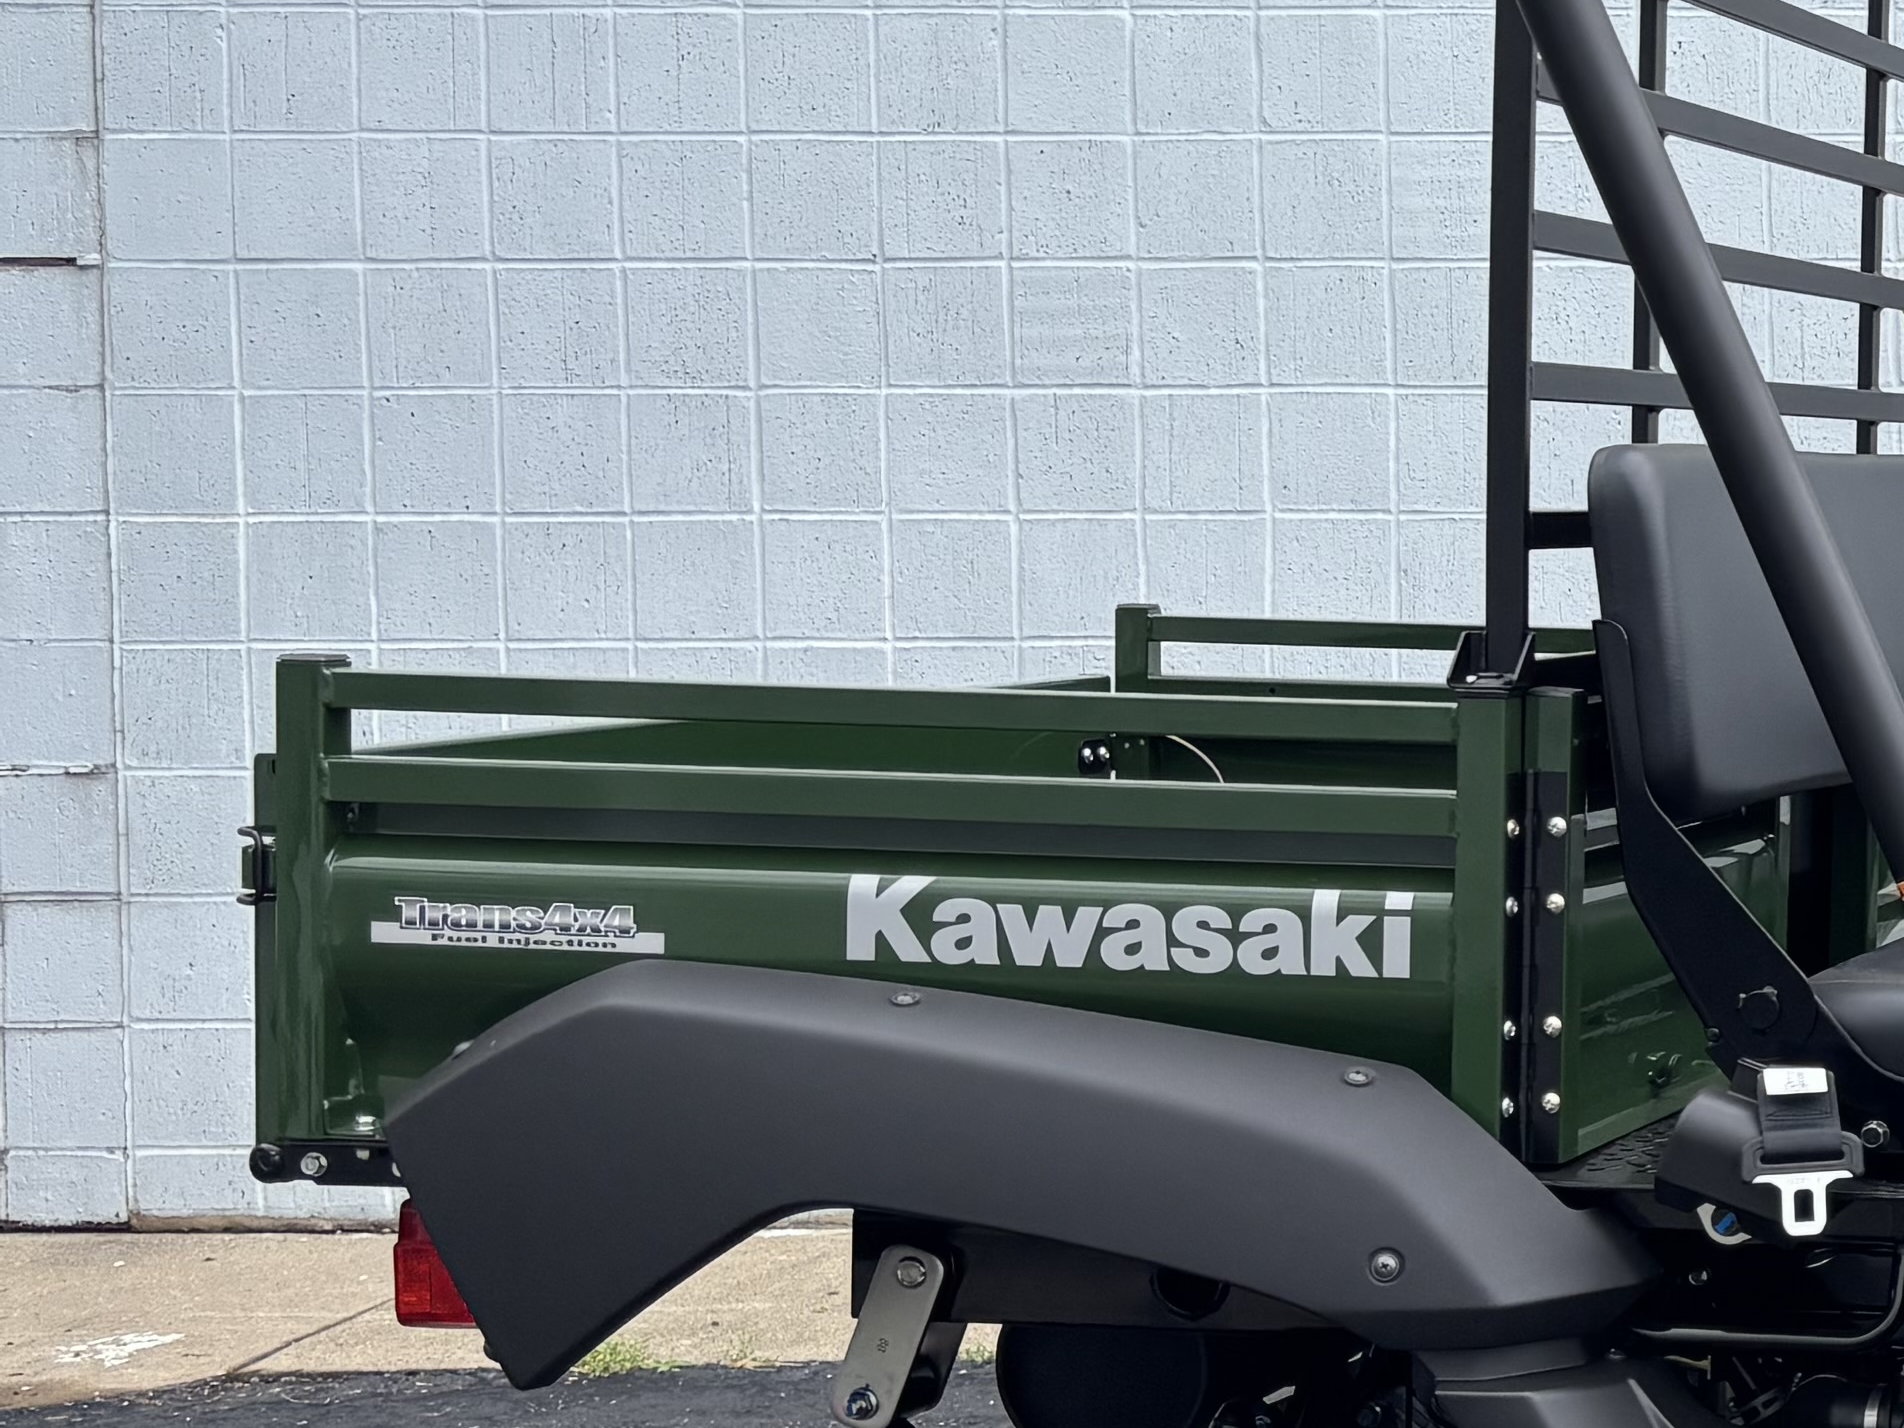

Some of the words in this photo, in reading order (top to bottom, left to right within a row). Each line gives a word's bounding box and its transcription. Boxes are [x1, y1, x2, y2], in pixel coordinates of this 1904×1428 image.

[394, 896, 638, 938] Trans4x4
[845, 873, 1415, 979] Kawasaki
[430, 932, 488, 944] Fuel
[498, 935, 617, 950] Injection
